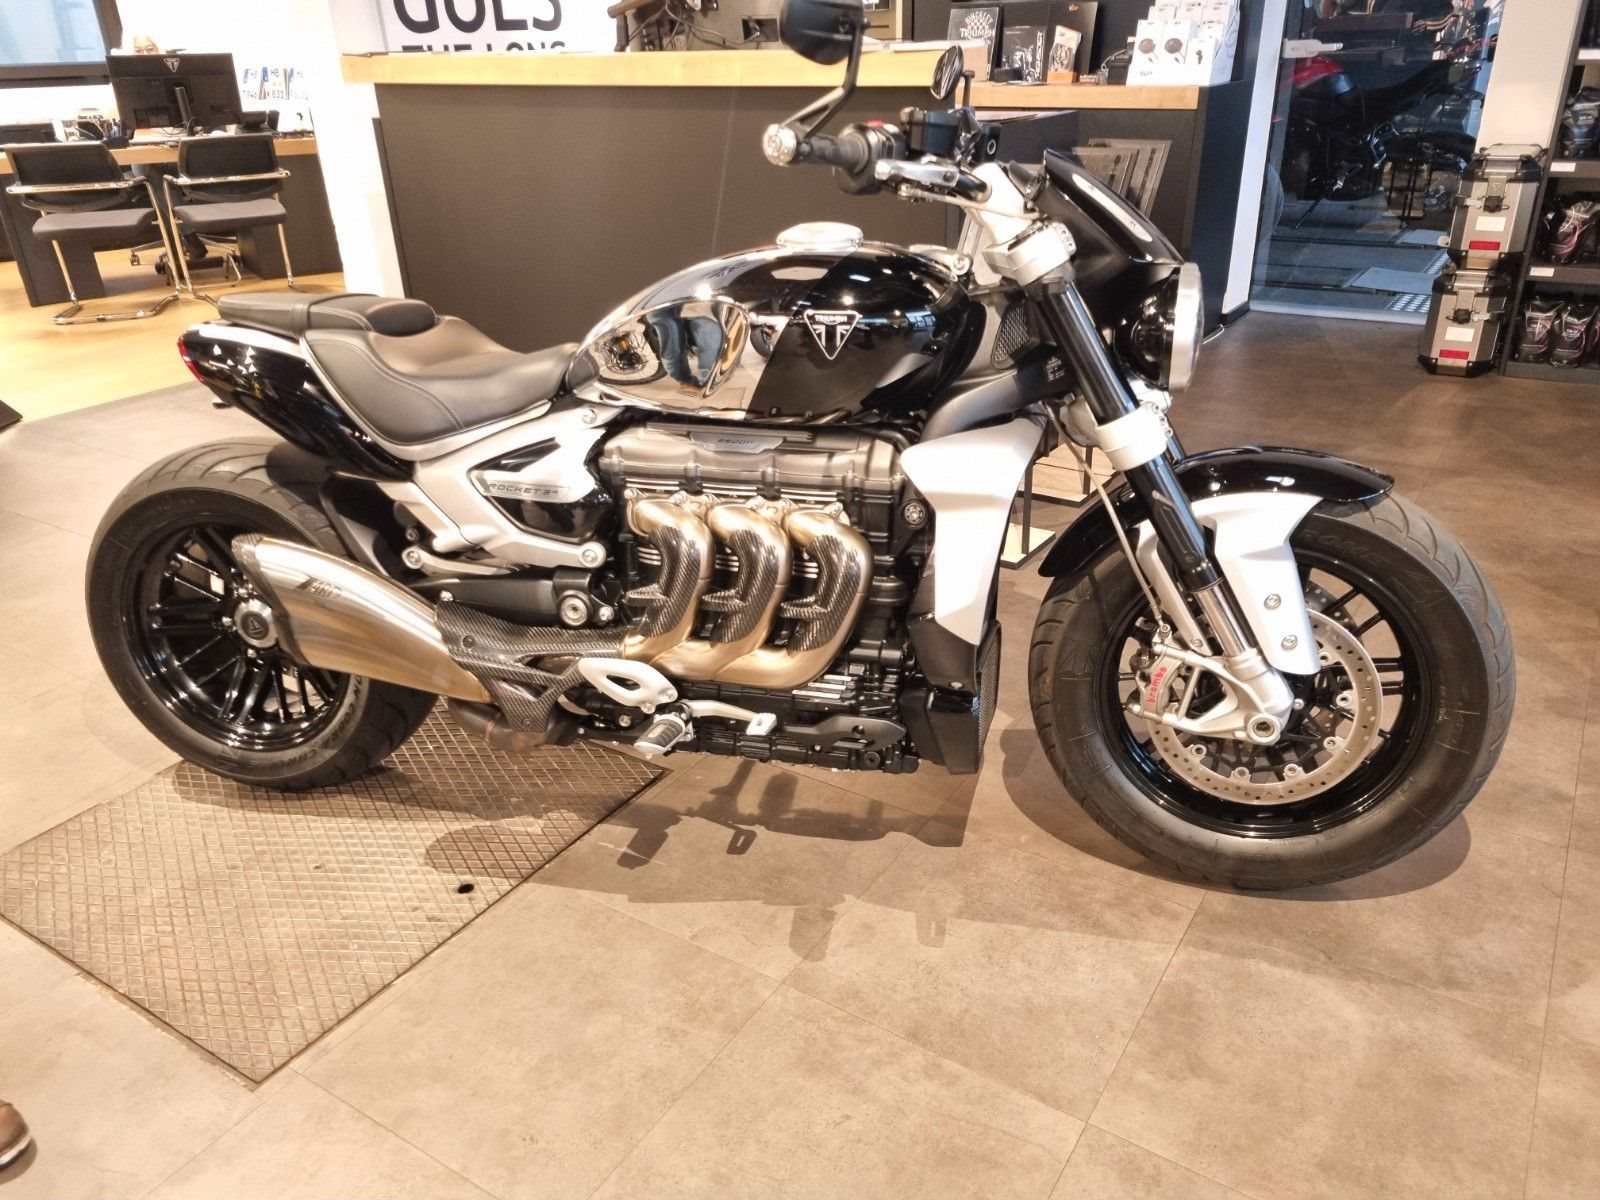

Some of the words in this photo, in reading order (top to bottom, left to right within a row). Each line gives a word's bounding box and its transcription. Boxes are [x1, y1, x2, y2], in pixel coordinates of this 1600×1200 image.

[959, 27, 995, 38] TRIUMPH
[489, 483, 541, 495] ROCKET
[1146, 666, 1168, 705] brembo
